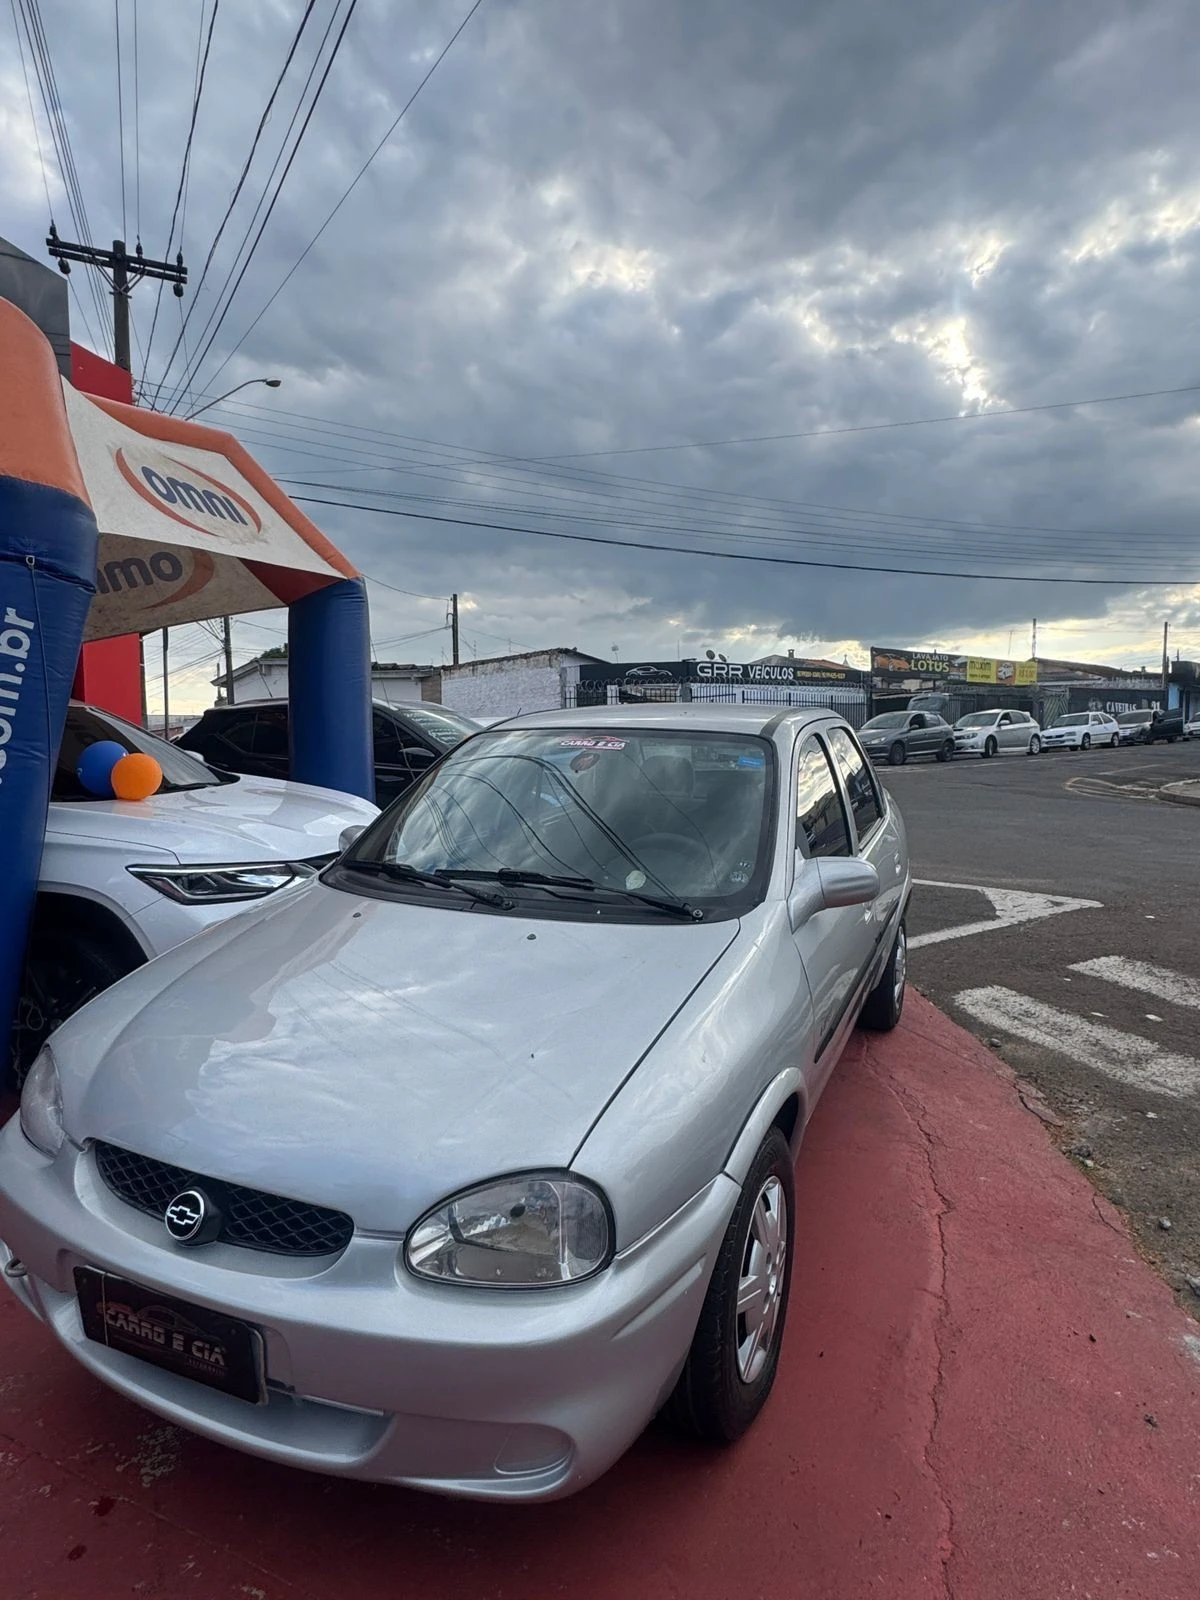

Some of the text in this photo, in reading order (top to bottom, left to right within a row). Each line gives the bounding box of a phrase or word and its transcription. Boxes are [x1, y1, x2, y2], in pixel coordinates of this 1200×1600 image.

[141, 466, 248, 526] omni
[697, 663, 743, 679] GRR
[748, 664, 794, 680] VEÍCULOS
[911, 659, 950, 673] LOTUS
[172, 1332, 185, 1351] E
